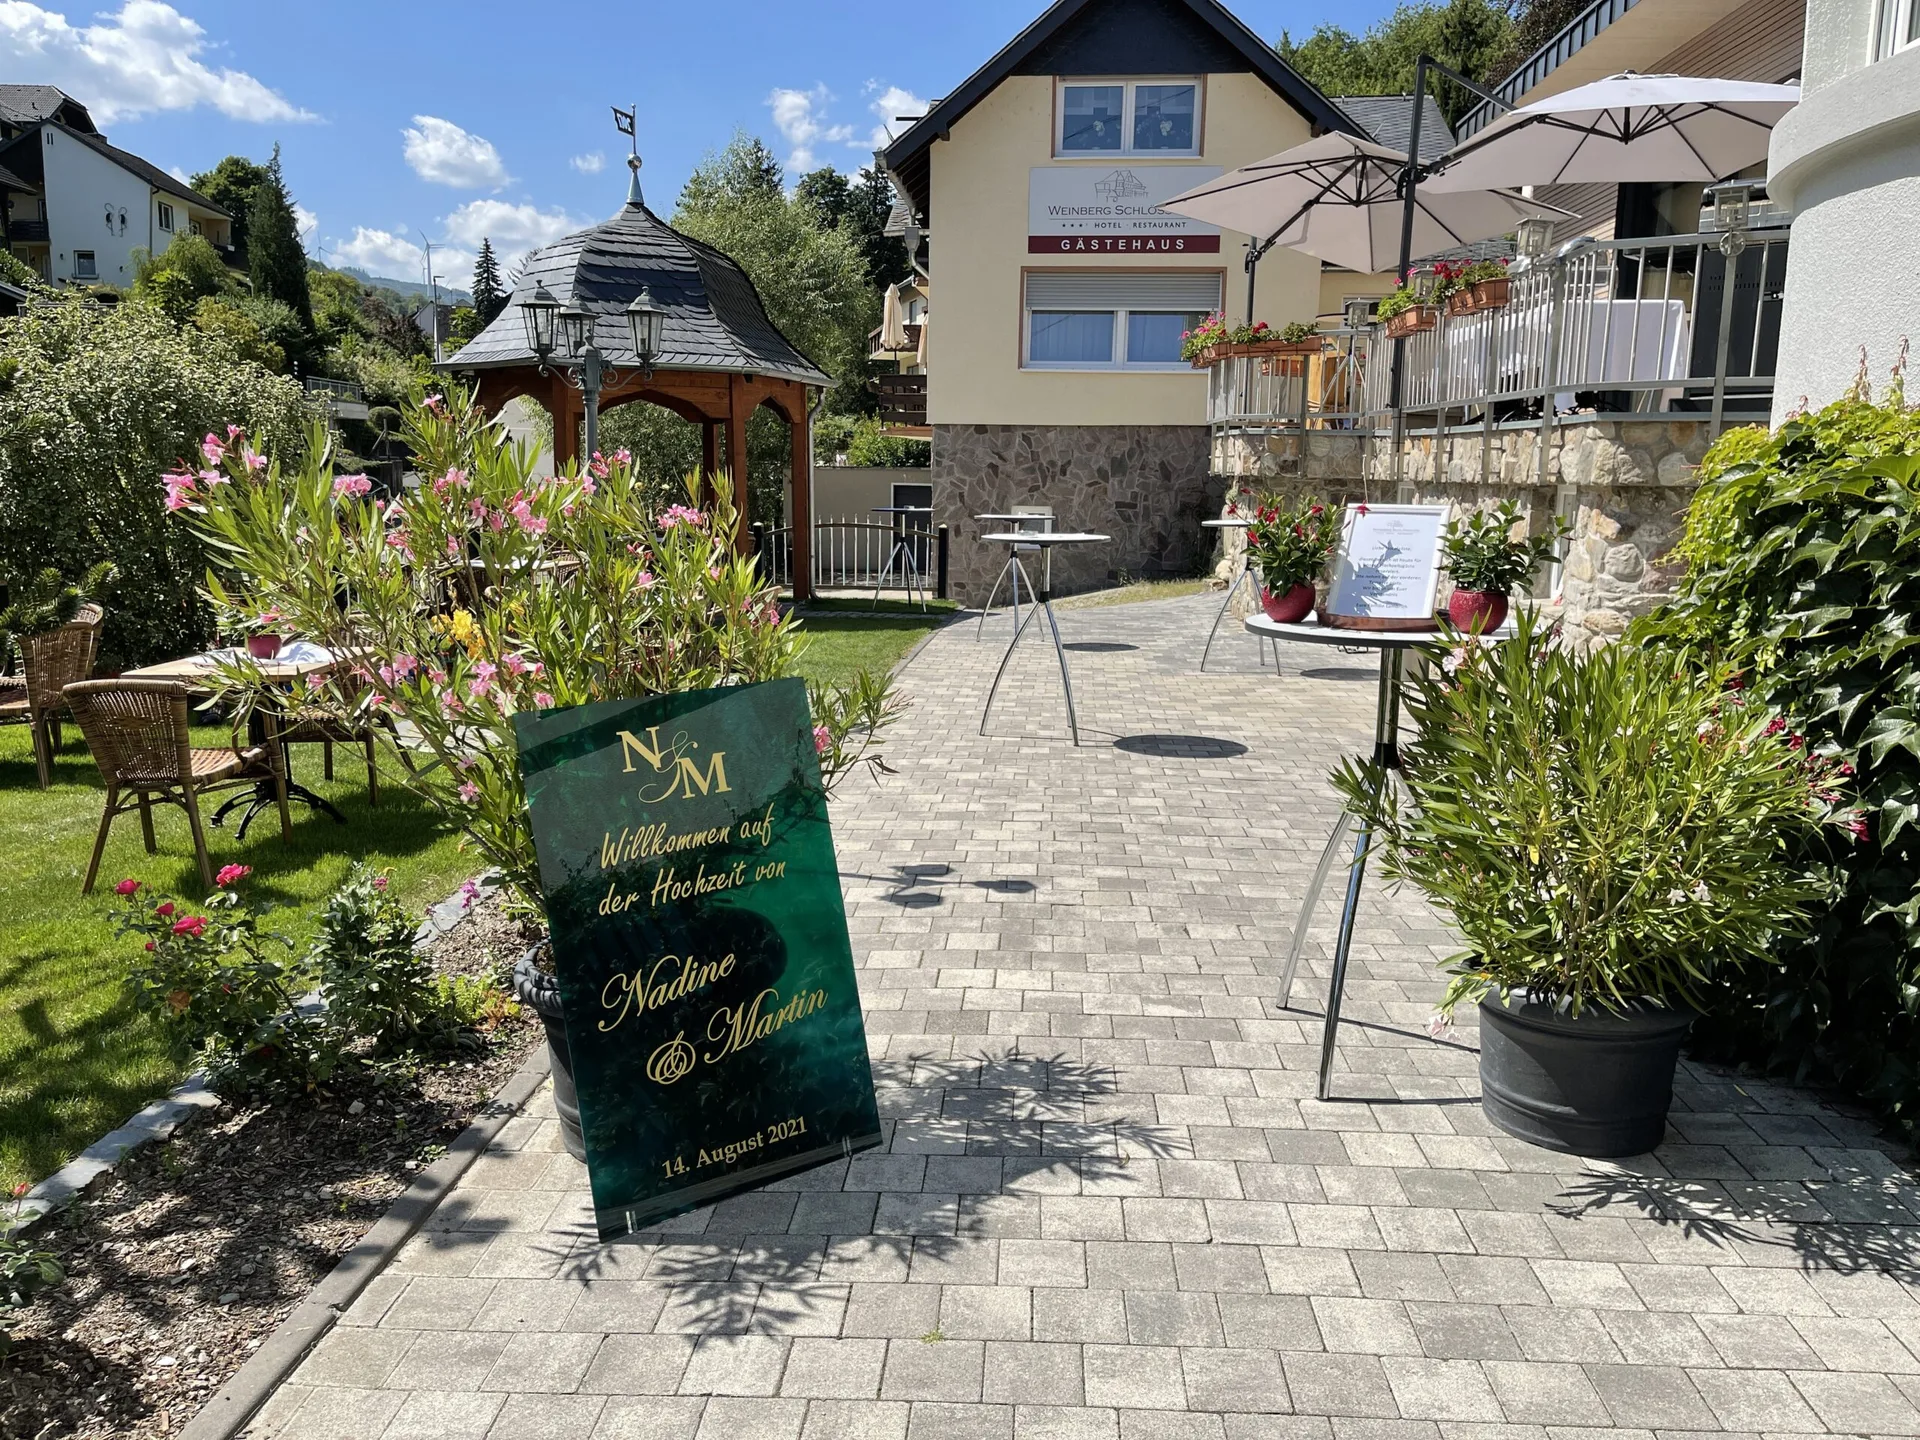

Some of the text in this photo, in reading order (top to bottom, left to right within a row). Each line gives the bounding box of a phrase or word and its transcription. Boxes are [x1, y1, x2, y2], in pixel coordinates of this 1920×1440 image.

[1048, 205, 1112, 216] WEINBERG
[1060, 237, 1185, 250] GÄSTEHAUS
[601, 802, 775, 869] Willkommen auf
[598, 859, 787, 916] der Hochzeit von
[598, 953, 736, 1032] Nadine
[646, 988, 829, 1085] & Martin
[661, 1115, 808, 1179] 14. August 2021
